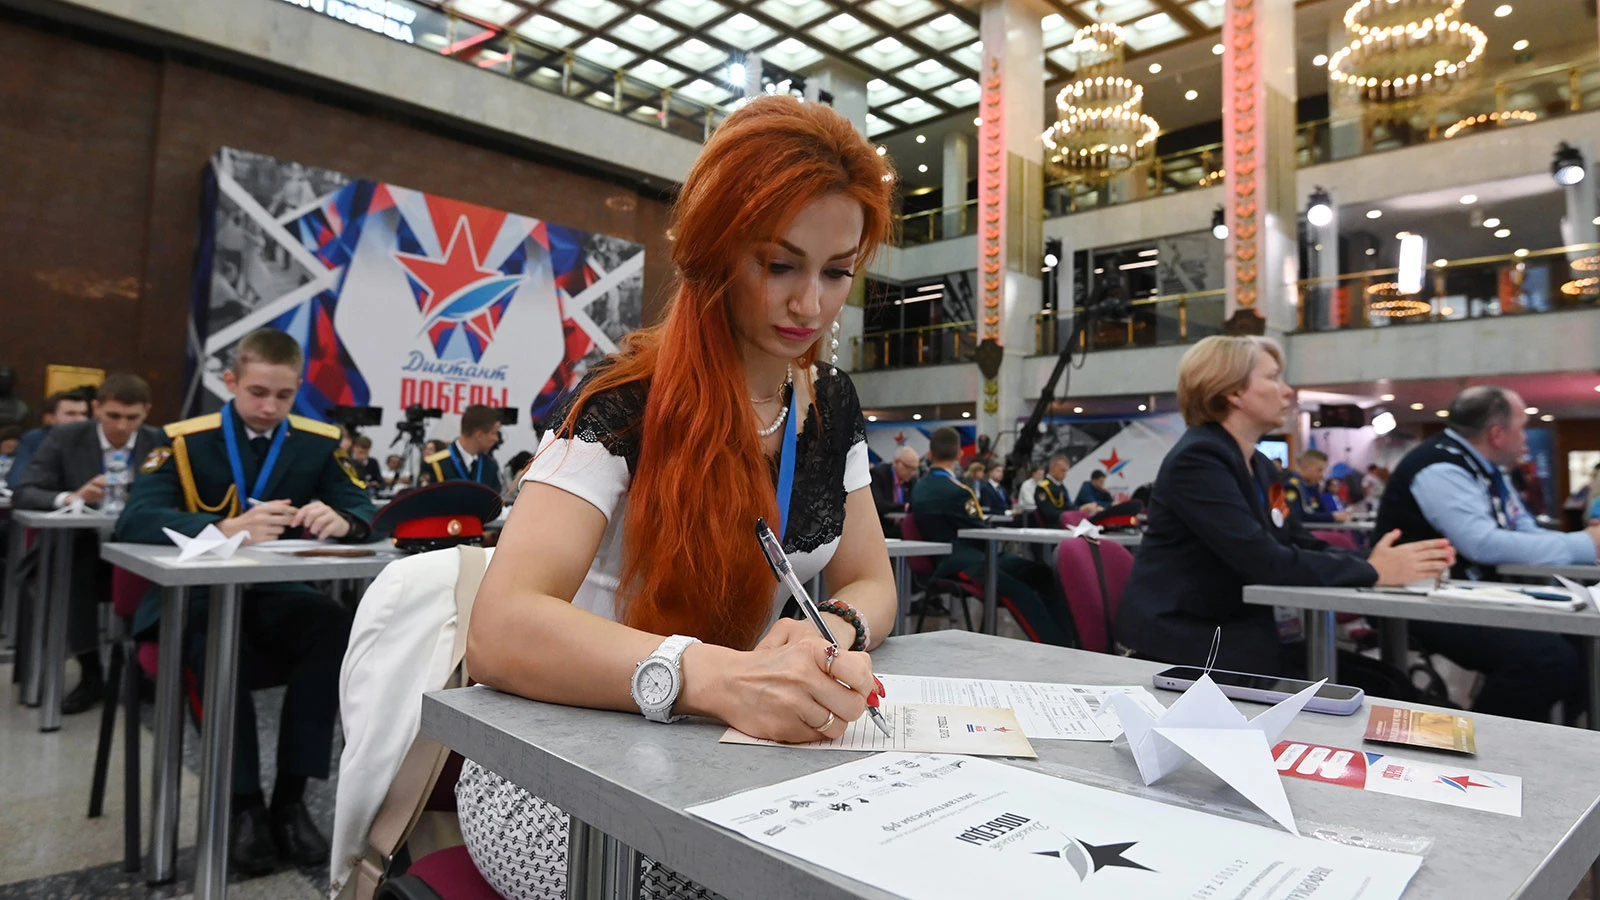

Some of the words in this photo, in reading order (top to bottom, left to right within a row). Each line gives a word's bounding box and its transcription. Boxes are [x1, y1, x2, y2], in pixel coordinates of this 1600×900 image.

[401, 350, 509, 381] Диктант
[400, 377, 508, 416] ПОБЕДЫ
[954, 812, 1031, 847] ПОБЕДЫ
[988, 820, 1051, 852] Диктант
[1285, 866, 1334, 900] ИНФОРМА
